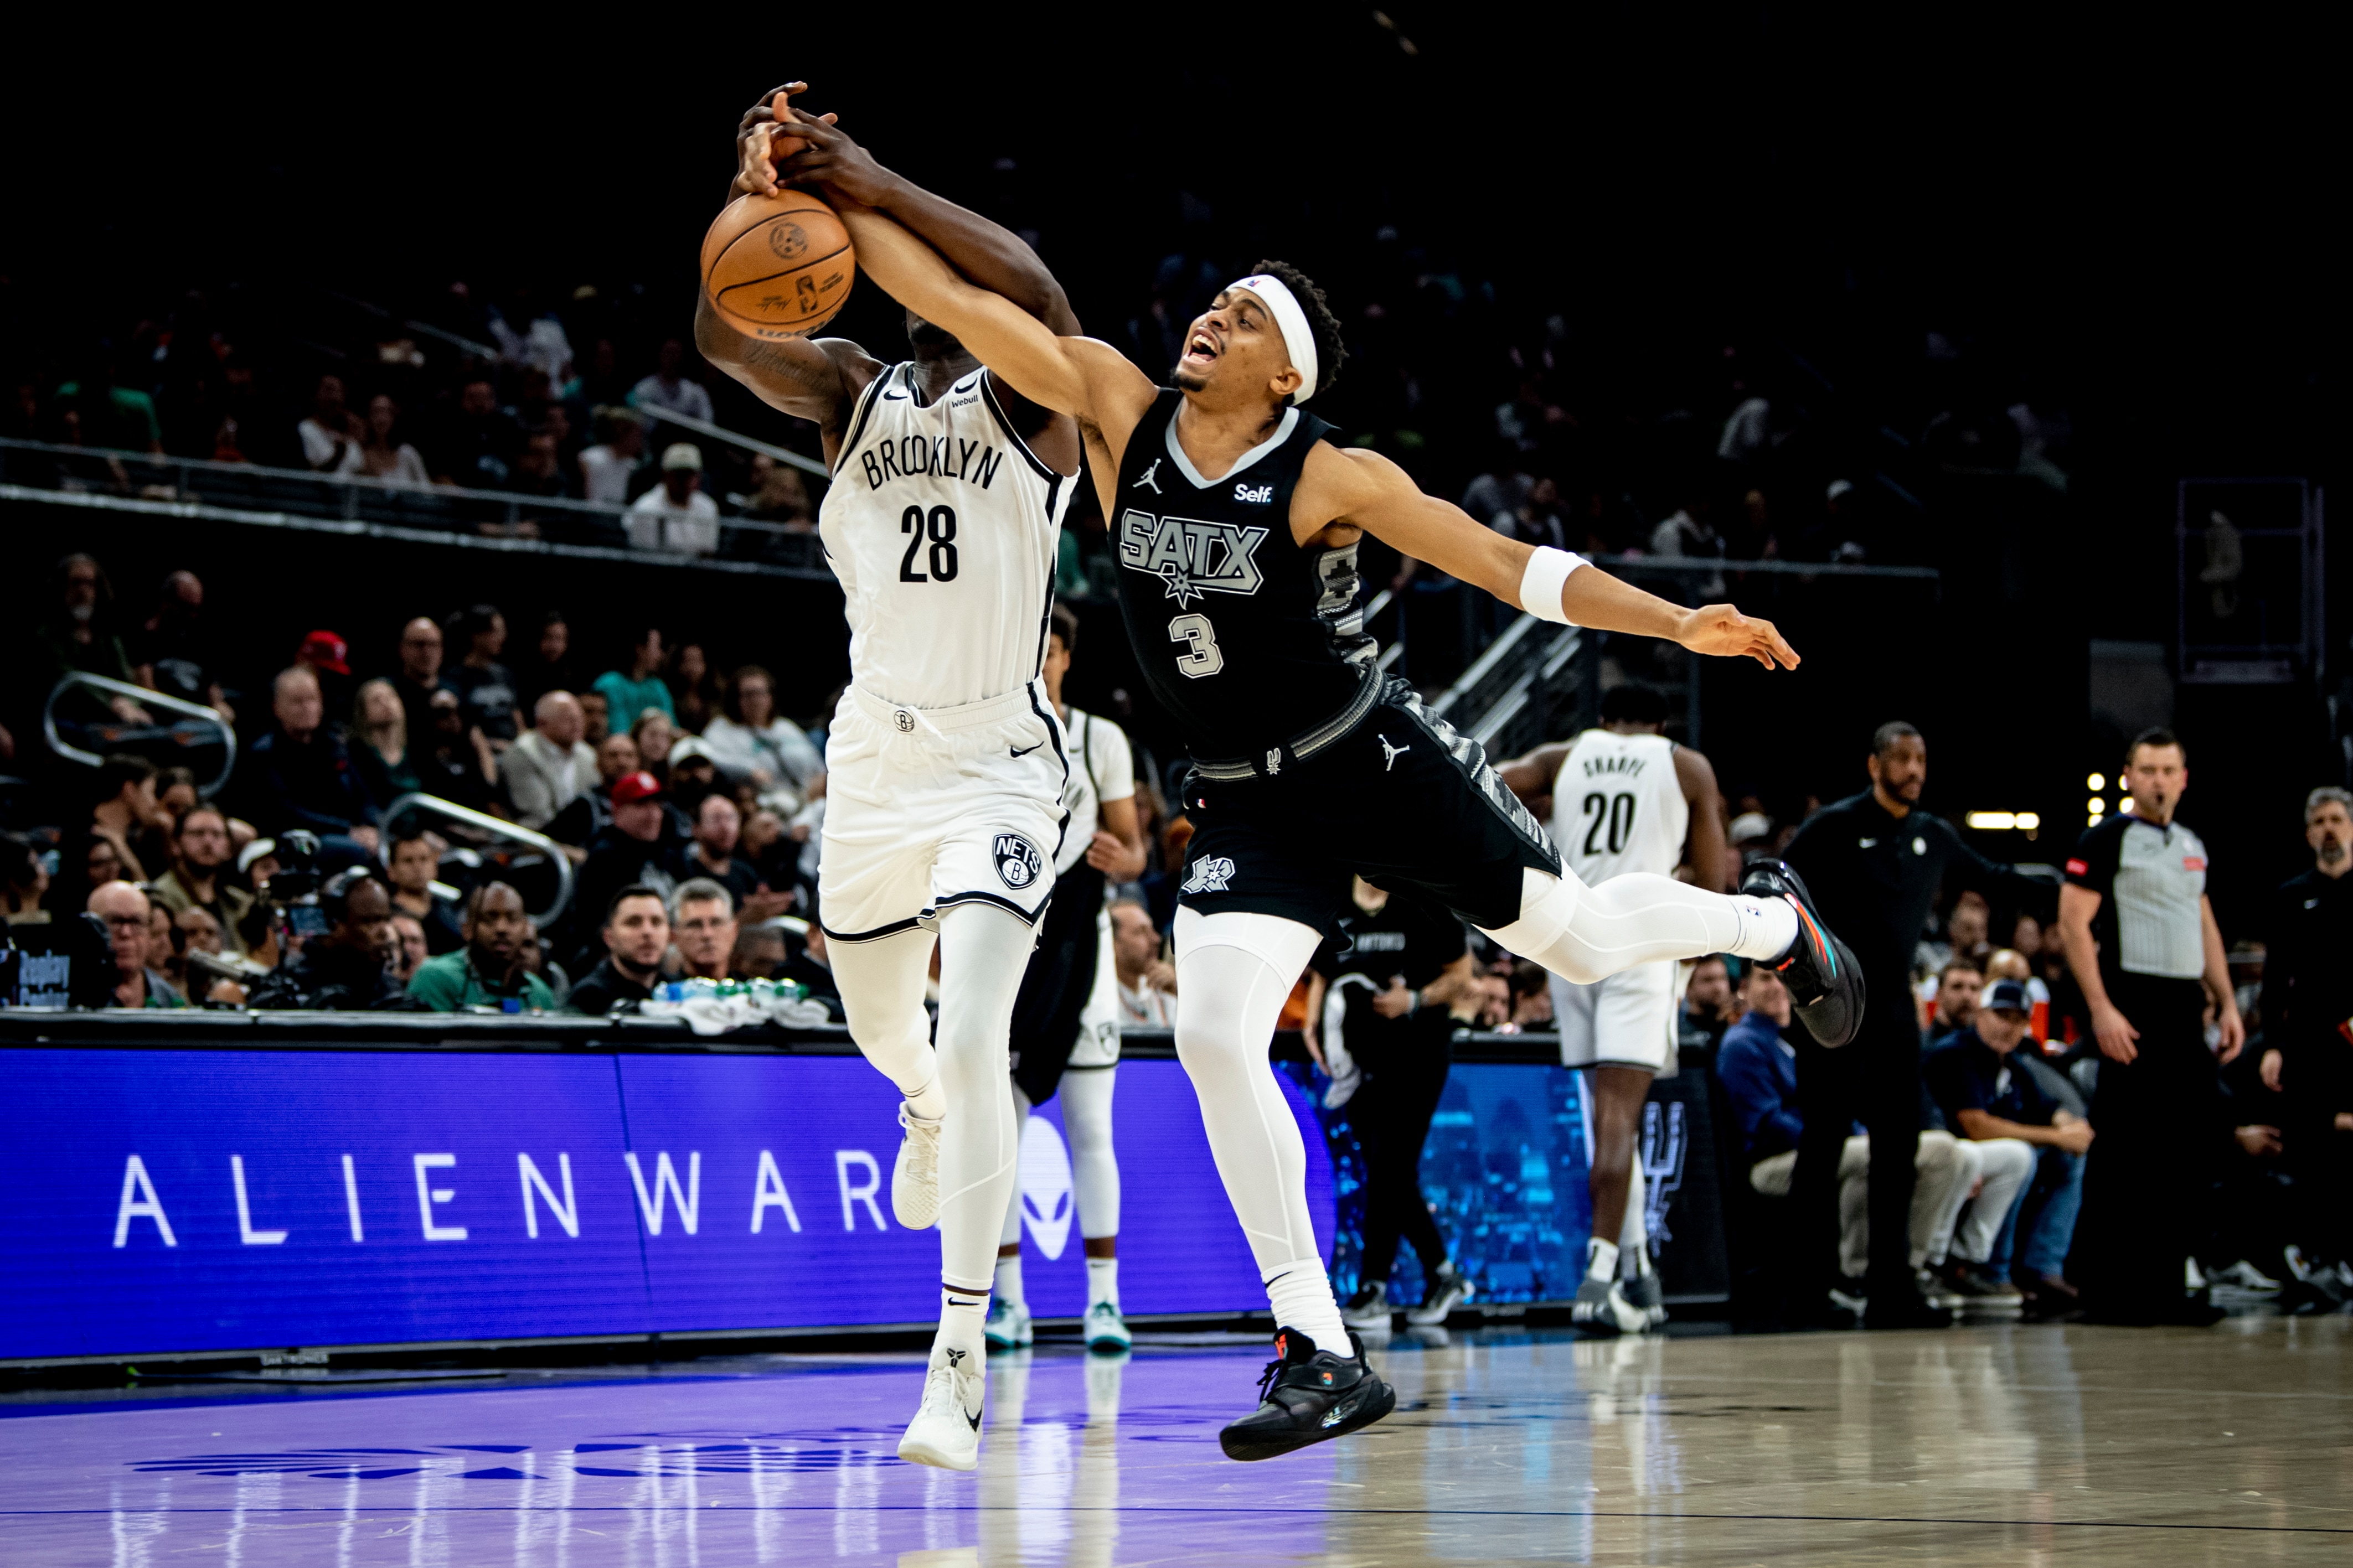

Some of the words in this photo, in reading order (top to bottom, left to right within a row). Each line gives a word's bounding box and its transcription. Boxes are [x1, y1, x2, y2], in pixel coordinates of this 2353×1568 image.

[951, 394, 978, 408] Webull
[861, 434, 1003, 491] BROOKLYN
[1234, 483, 1272, 503] Self.
[900, 505, 958, 583] 28
[1120, 508, 1270, 596] SATX
[1168, 613, 1224, 679] 3
[1583, 791, 1637, 857] 20
[995, 837, 1040, 874] NETS
[1011, 862, 1021, 881] B
[113, 1150, 940, 1248] ALIENWAR
